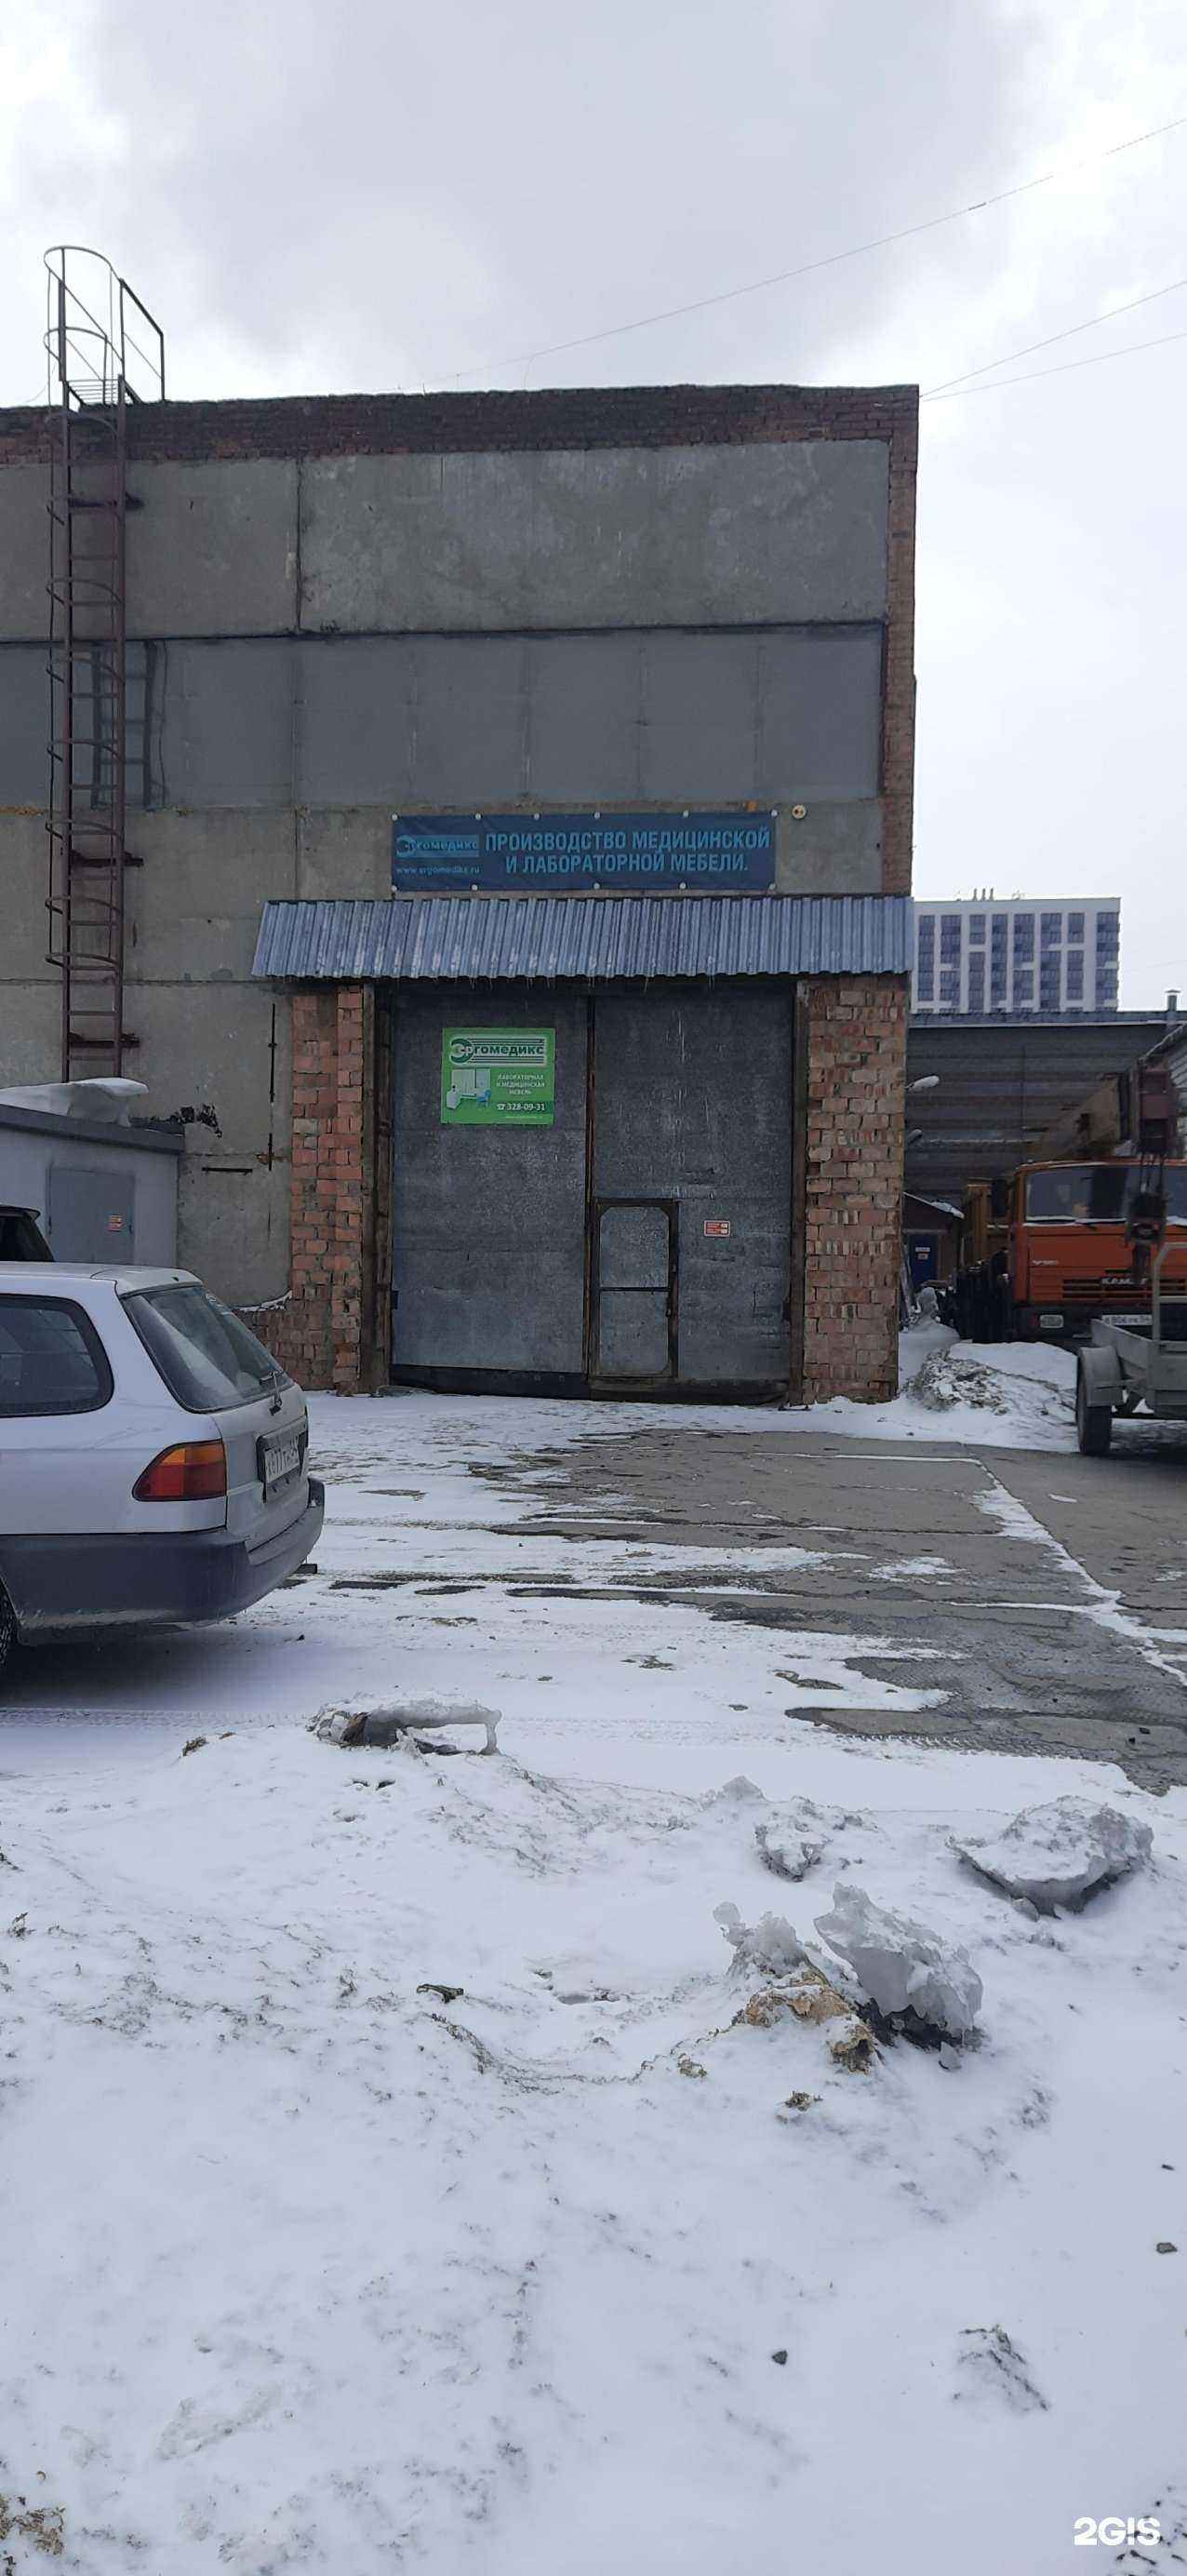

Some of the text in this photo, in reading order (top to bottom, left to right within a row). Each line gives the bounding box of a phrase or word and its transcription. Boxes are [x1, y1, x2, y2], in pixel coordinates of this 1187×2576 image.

[485, 826, 770, 853] ПРОИЗВОДСТВО МЕДИЦИНСКОЙ
[505, 851, 748, 873] И ЛАБОРАТОРНОЙ МЕБЕЛИ.
[506, 1103, 545, 1111] 328-09-31
